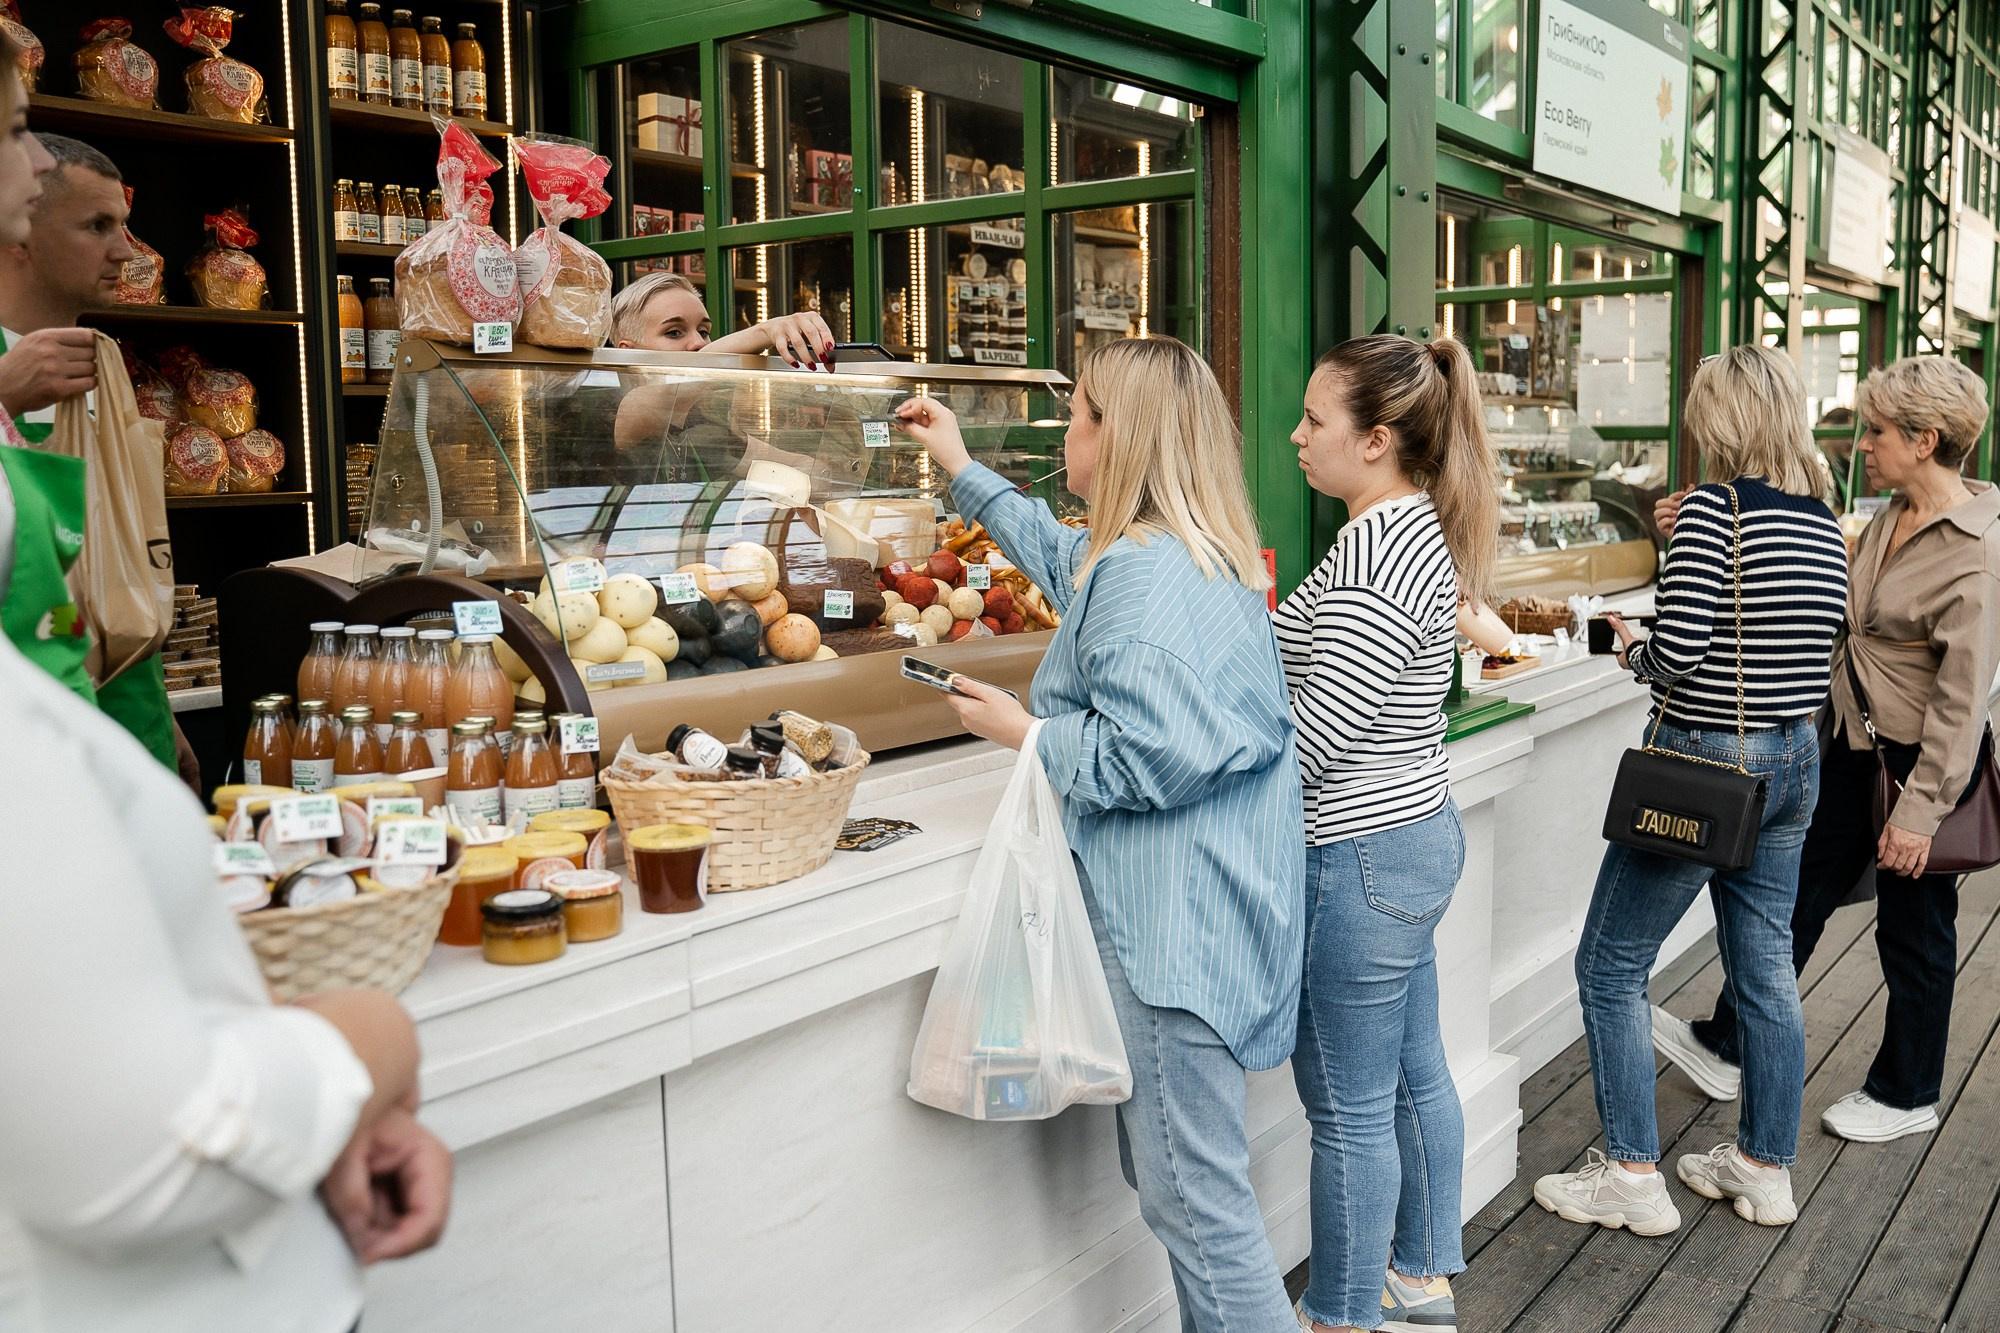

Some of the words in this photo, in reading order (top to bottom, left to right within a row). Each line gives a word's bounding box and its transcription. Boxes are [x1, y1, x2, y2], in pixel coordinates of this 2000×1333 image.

[1544, 100, 1564, 124] Eco
[1566, 108, 1592, 138] Berry
[974, 229, 1021, 246] ИВАН-ЧАЙ
[981, 350, 1021, 363] ВАРЕНЬЕ
[588, 667, 643, 677] Carboma
[1636, 809, 1699, 844] J'ADIOR
